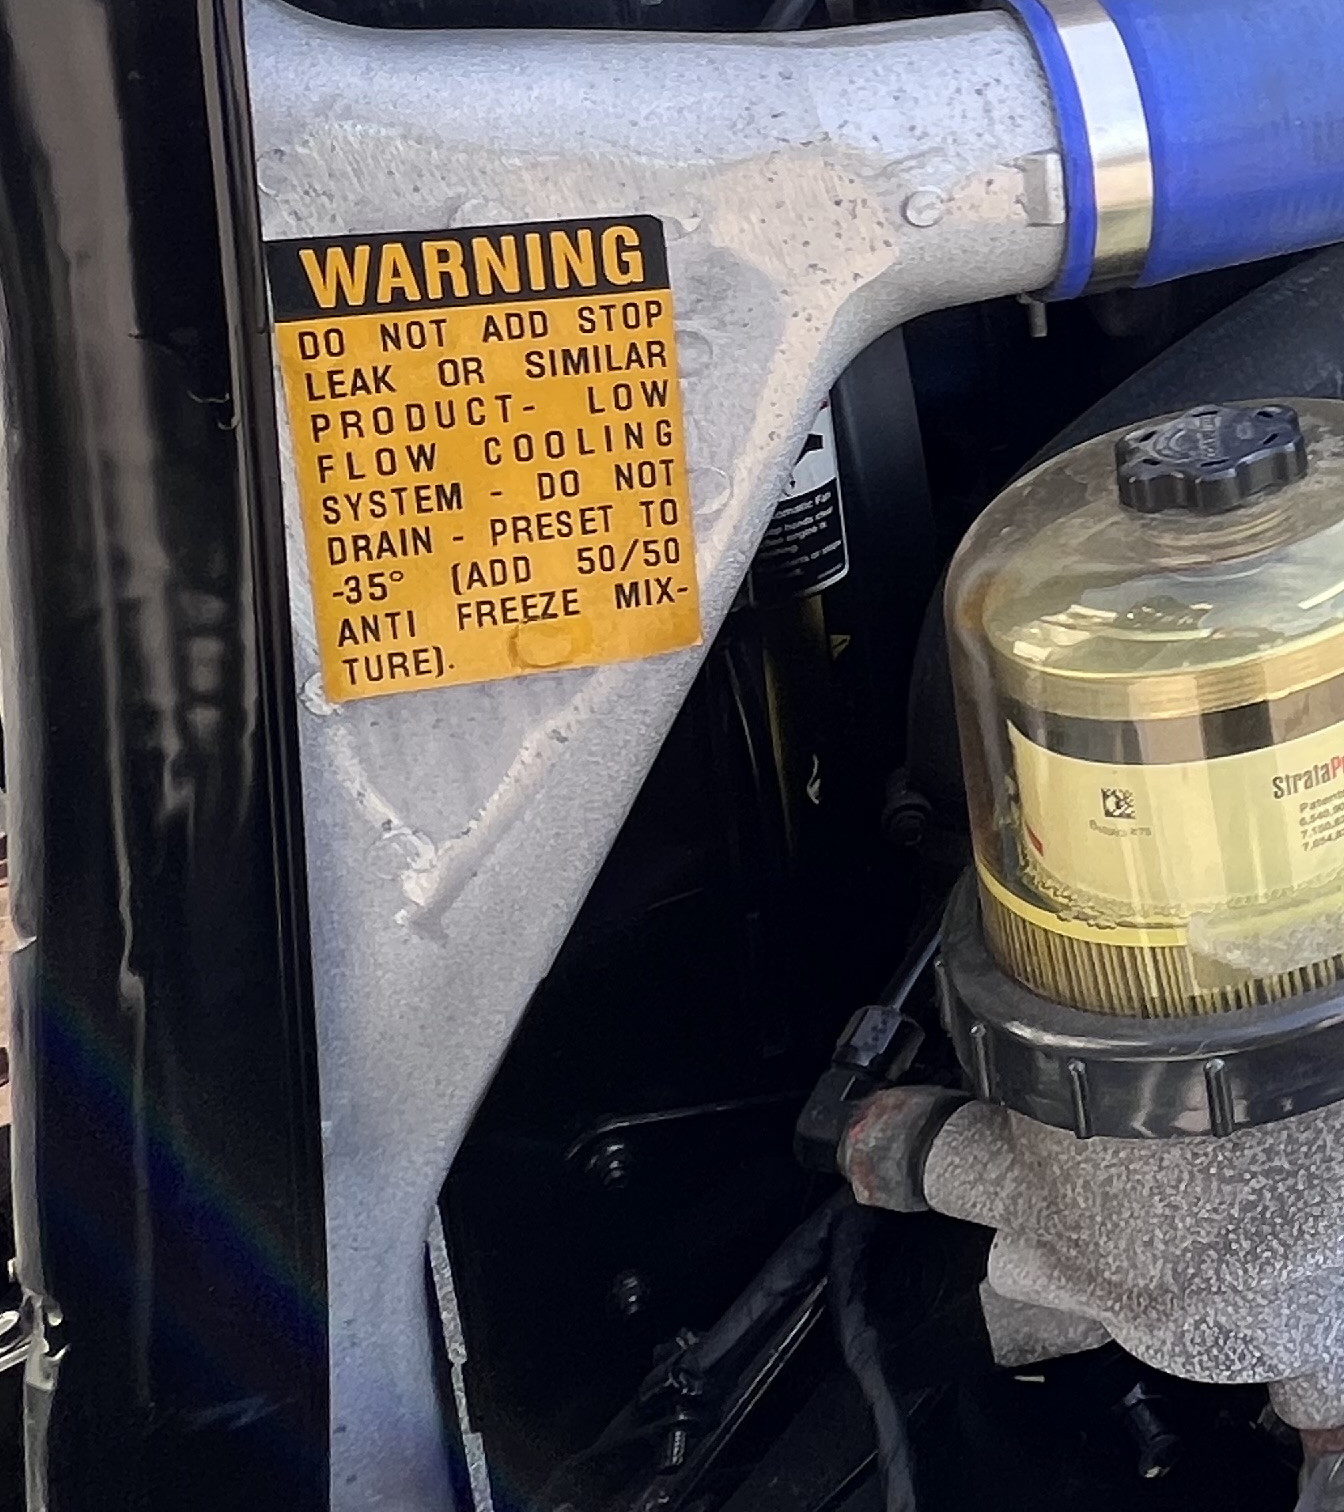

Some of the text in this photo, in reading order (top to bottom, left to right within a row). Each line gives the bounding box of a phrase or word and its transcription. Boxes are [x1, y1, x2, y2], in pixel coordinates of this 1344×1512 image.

[298, 224, 646, 308] WARNING
[298, 300, 664, 361] DO NOT ADD STOP
[305, 340, 668, 402] LEAK OR SIMILAR
[588, 380, 670, 415] LOW
[317, 418, 674, 483] FLOW COOLING
[321, 482, 464, 525] SYSTEM
[537, 469, 580, 501] DO
[614, 458, 676, 491] NOT
[327, 526, 434, 567] DRAIN
[490, 504, 614, 547] PRESET
[639, 498, 678, 529] TO
[577, 536, 682, 576] 50/50
[337, 575, 690, 648] ANTI FREEZE MIX-
